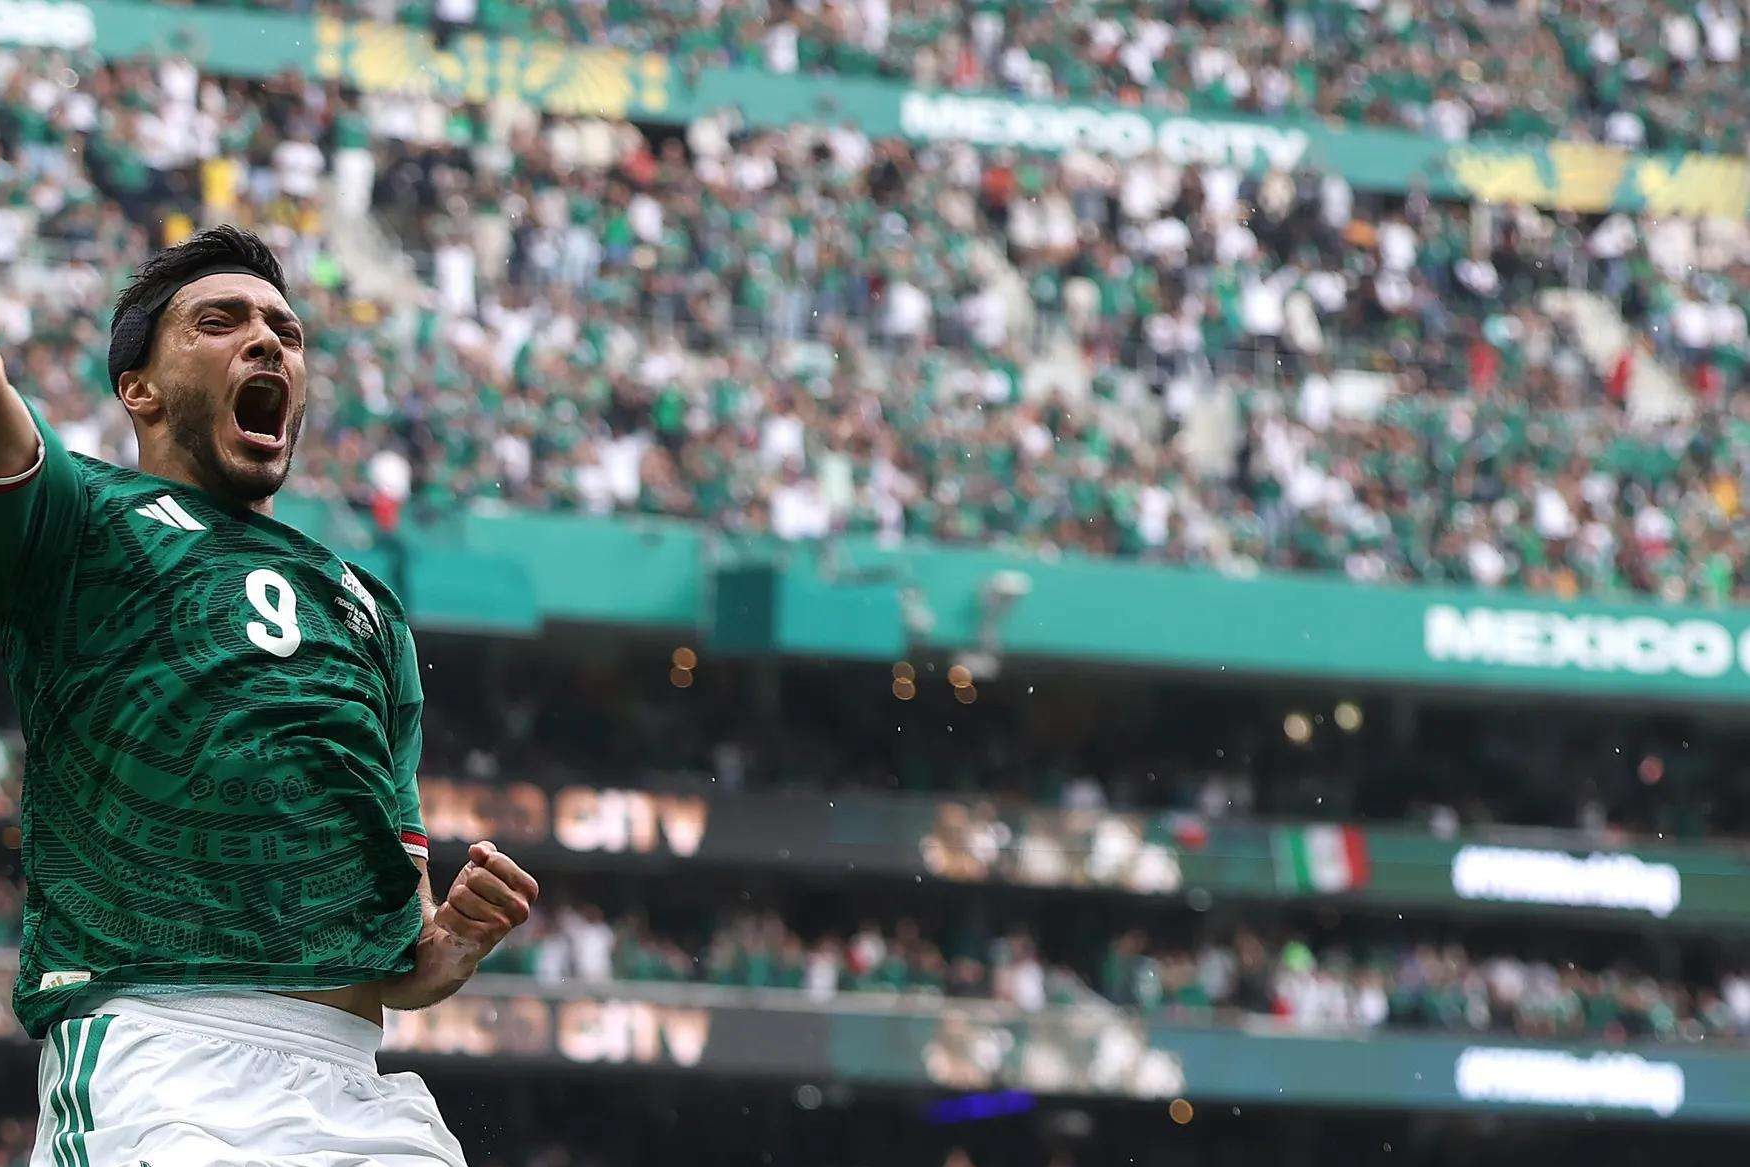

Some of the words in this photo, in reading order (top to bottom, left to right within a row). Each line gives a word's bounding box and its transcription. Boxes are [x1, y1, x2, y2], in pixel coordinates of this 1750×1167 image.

[900, 90, 1153, 158] MEXICO
[1158, 117, 1308, 172] CITY
[245, 568, 302, 658] 9
[1424, 604, 1735, 678] MEXICO
